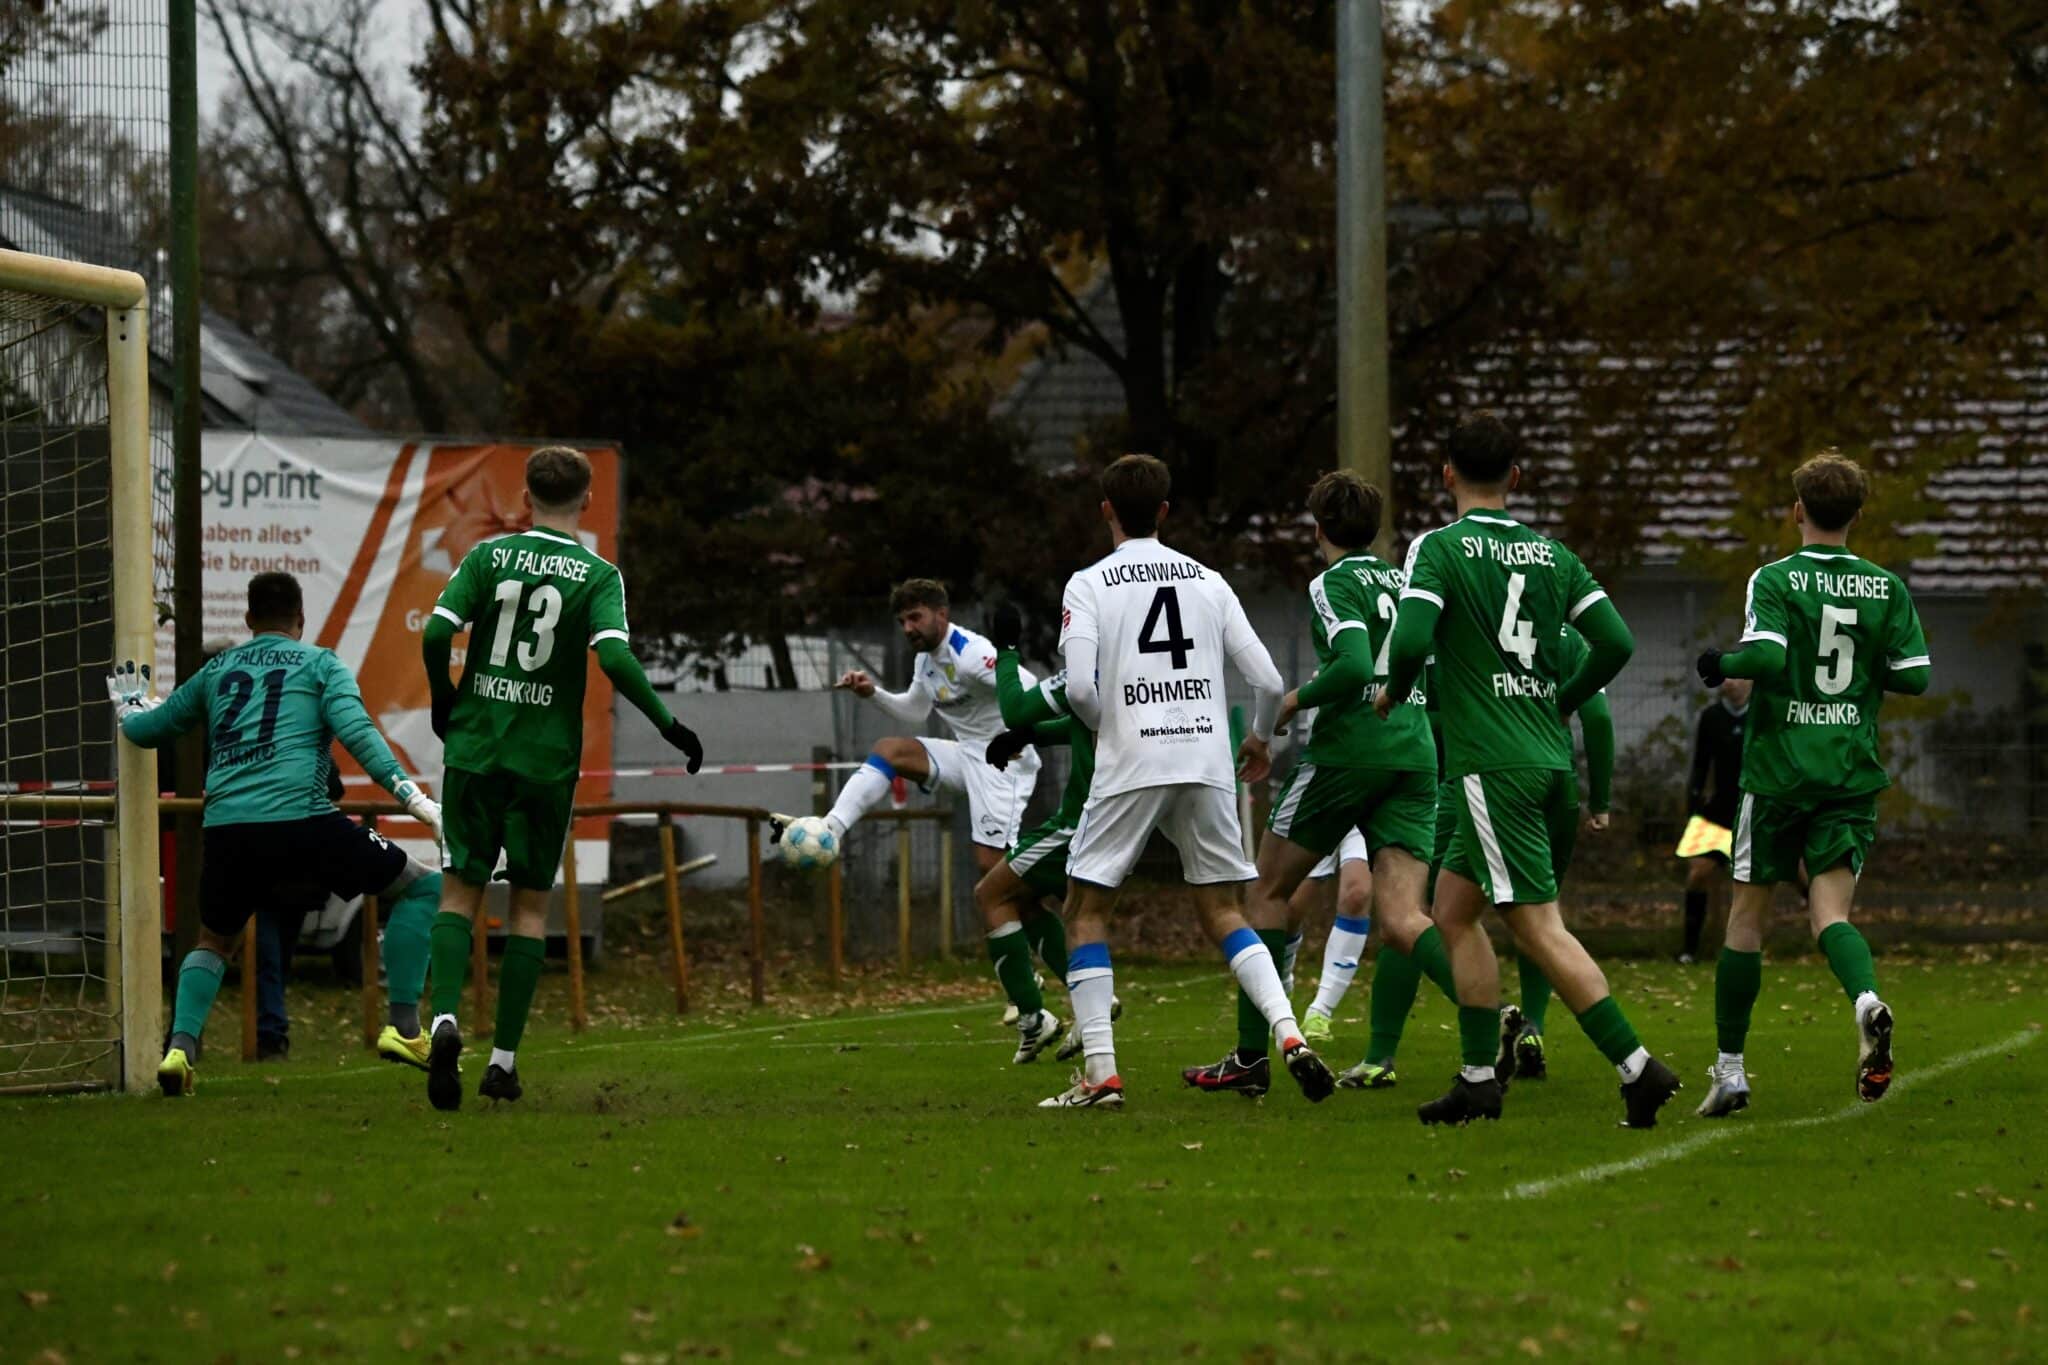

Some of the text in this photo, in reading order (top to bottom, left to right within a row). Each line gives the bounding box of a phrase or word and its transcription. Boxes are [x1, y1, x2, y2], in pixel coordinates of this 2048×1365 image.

[243, 461, 323, 508] print
[201, 522, 252, 542] aben
[1461, 536, 1483, 558] SV
[230, 552, 321, 573] brauchen
[492, 548, 591, 582] SV FALKENSEE
[1102, 562, 1205, 587] LUCKENWALDE
[1788, 570, 1808, 592] SV
[489, 579, 562, 672] 13
[1138, 586, 1194, 670] 4
[1498, 572, 1537, 669] 4
[1814, 603, 1857, 695] 5
[1124, 677, 1212, 706] BÖHMERT
[215, 669, 287, 746] 21
[1140, 724, 1213, 738] Märkischer Hof
